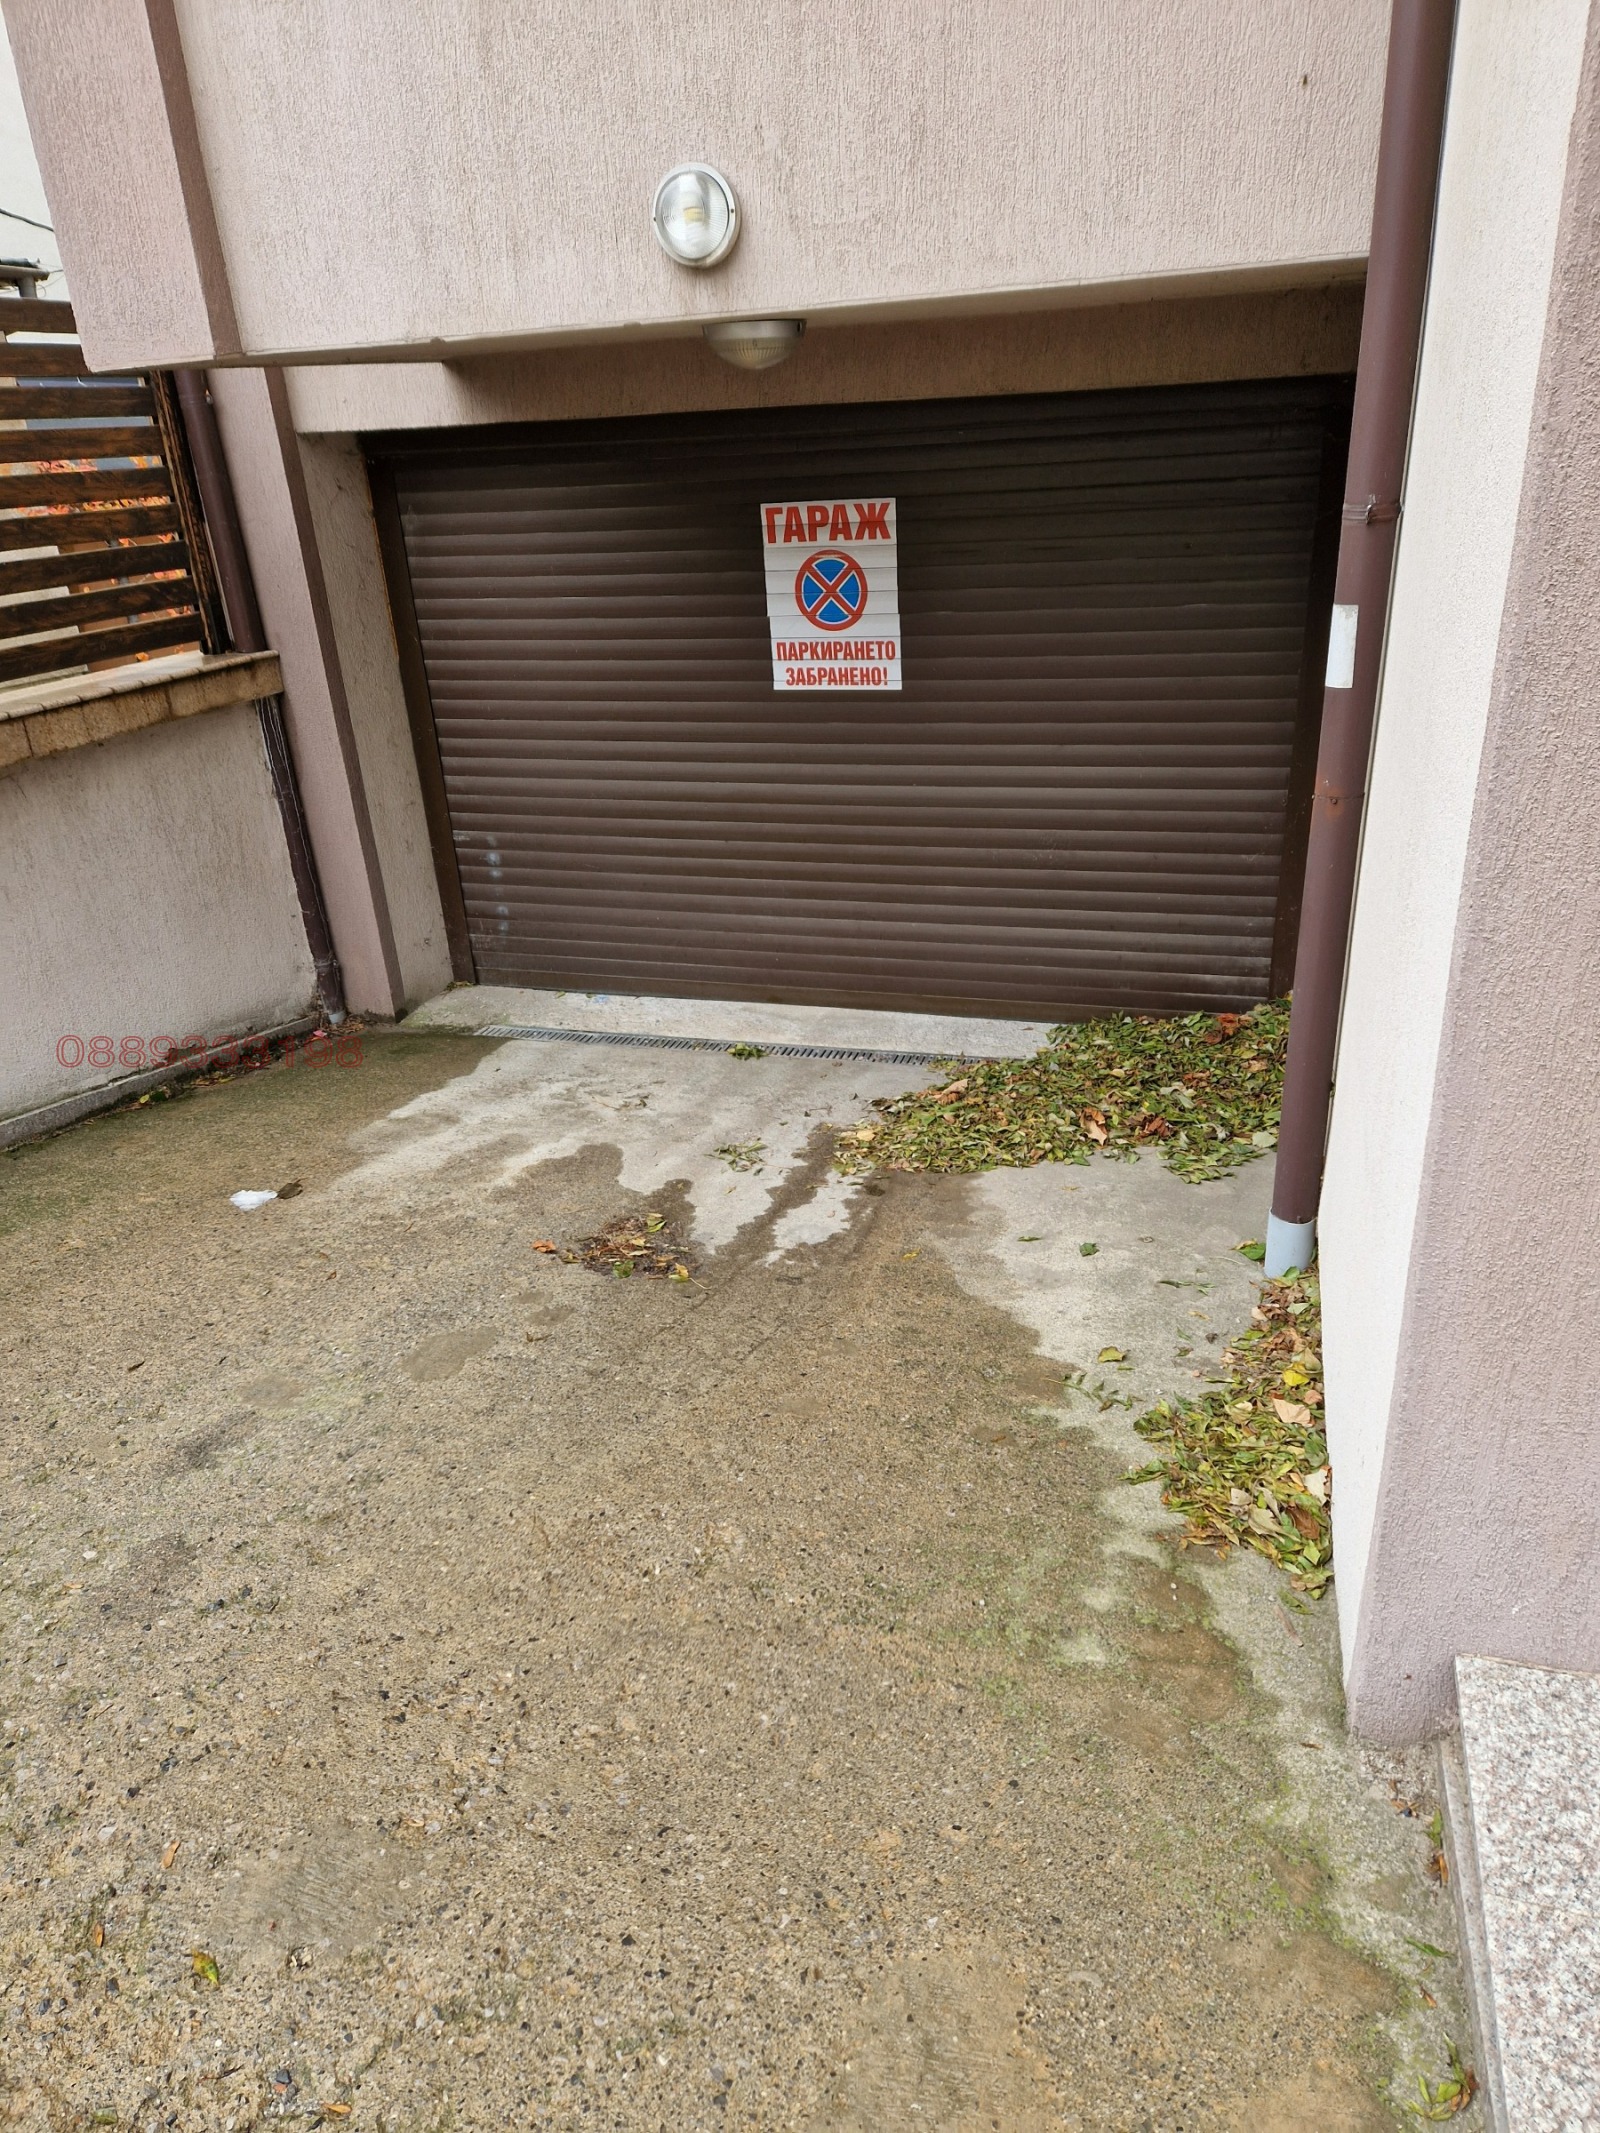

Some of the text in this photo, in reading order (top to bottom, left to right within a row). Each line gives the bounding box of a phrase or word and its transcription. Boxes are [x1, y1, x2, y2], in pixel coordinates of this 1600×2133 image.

[765, 502, 891, 544] ГАРАЖ
[776, 640, 896, 661] ПАРКИРАНЕТО
[786, 666, 888, 686] ЗАБРАНЕНО!
